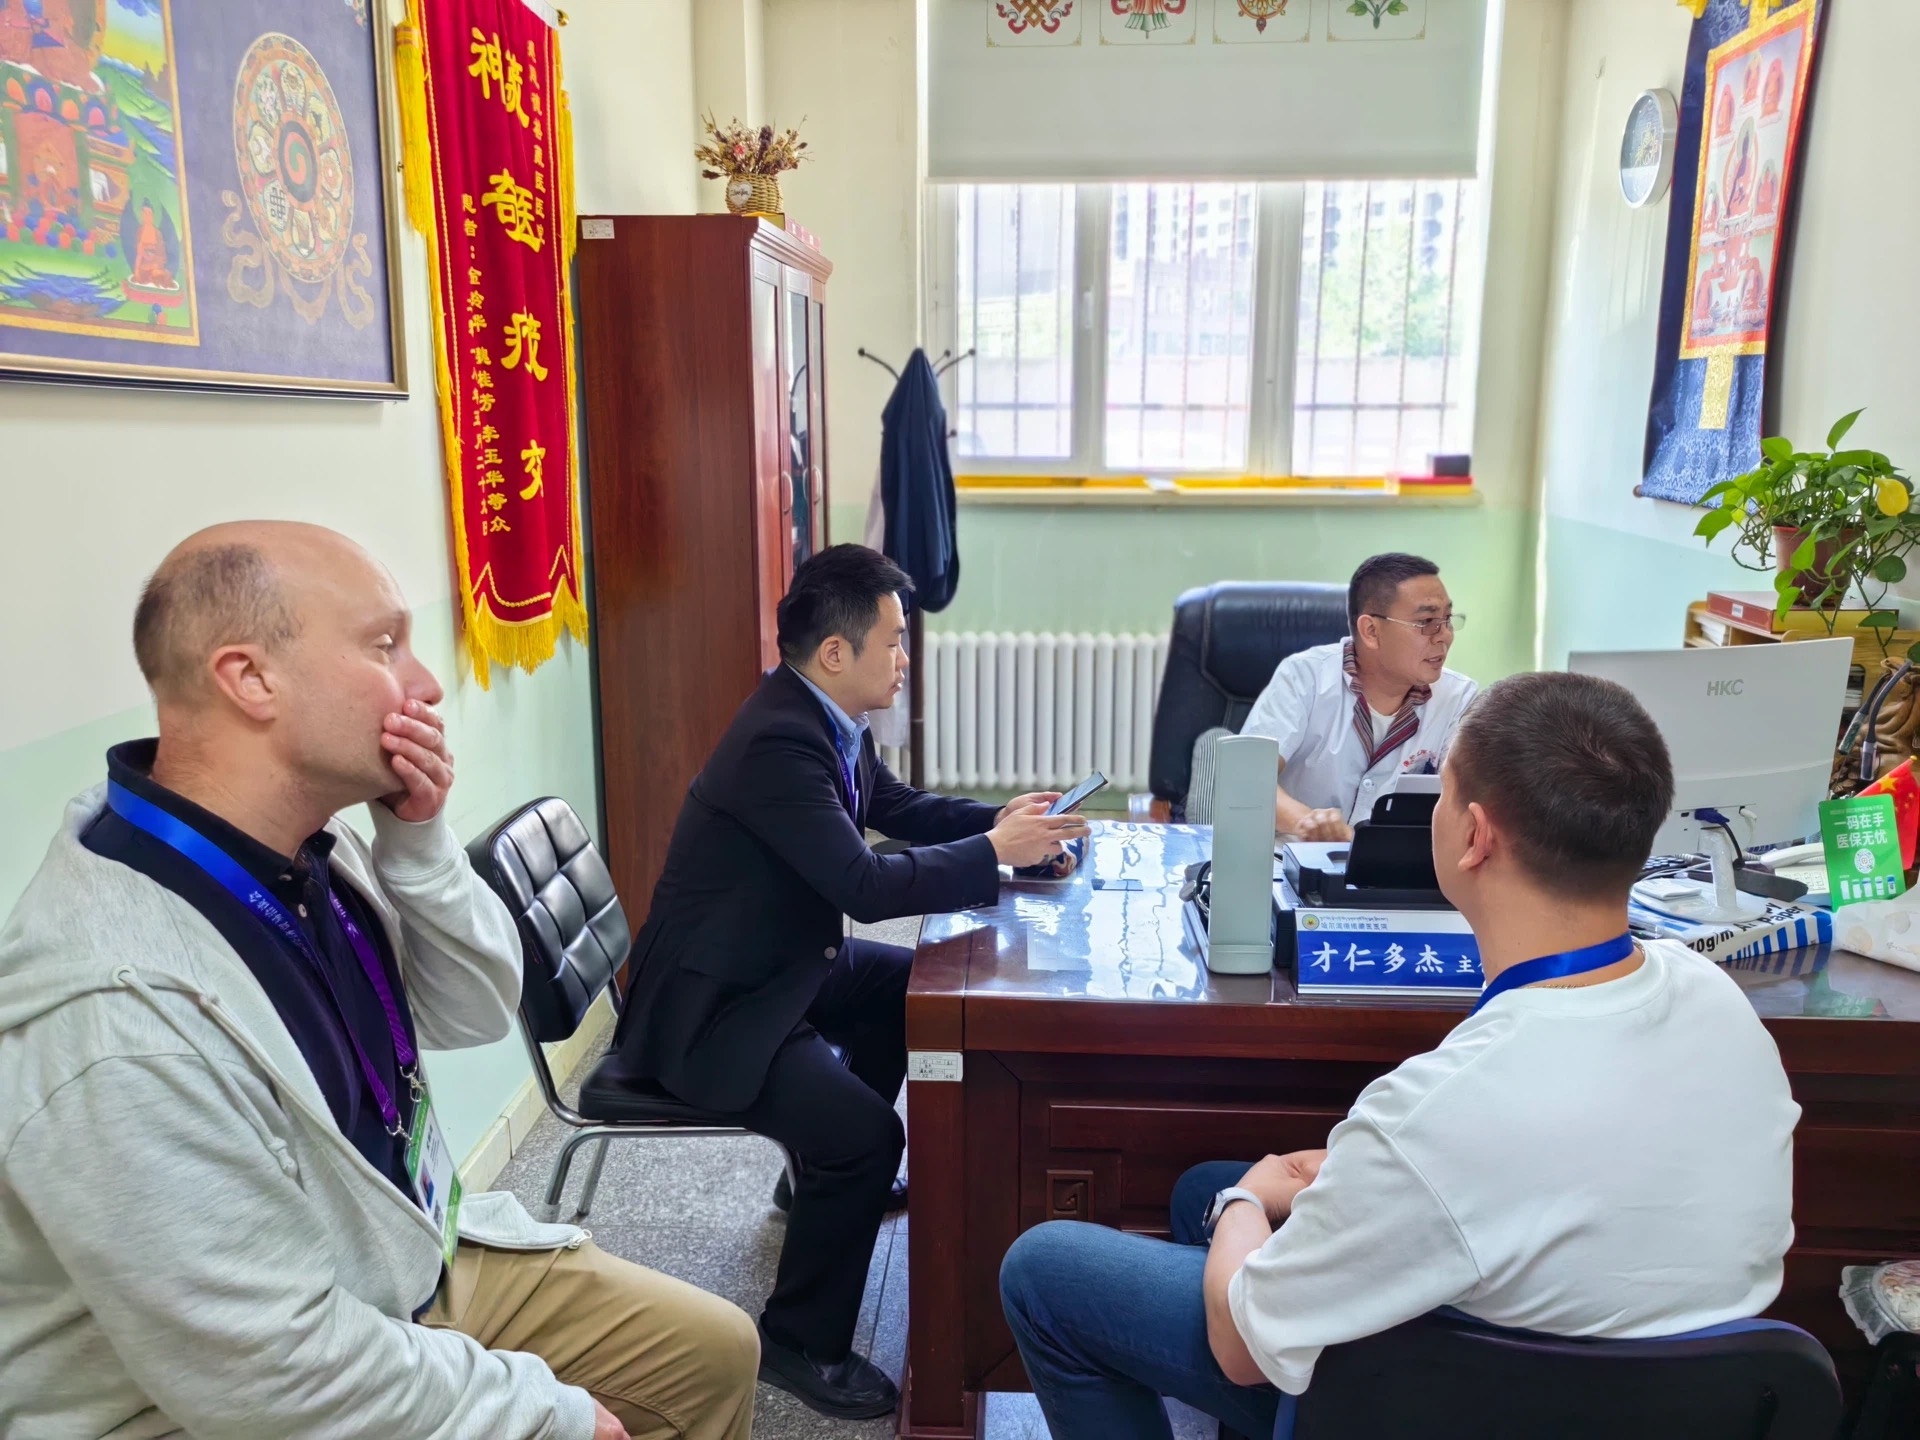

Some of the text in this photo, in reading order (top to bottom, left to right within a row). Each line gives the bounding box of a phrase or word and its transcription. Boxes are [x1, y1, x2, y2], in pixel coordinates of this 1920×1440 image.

[1707, 679, 1744, 696] HKC
[1834, 812, 1884, 829] 一码在手
[1836, 829, 1888, 849] 医保无忧
[1757, 906, 1804, 925] Paper
[1310, 941, 1484, 974] 才仁多杰 主
